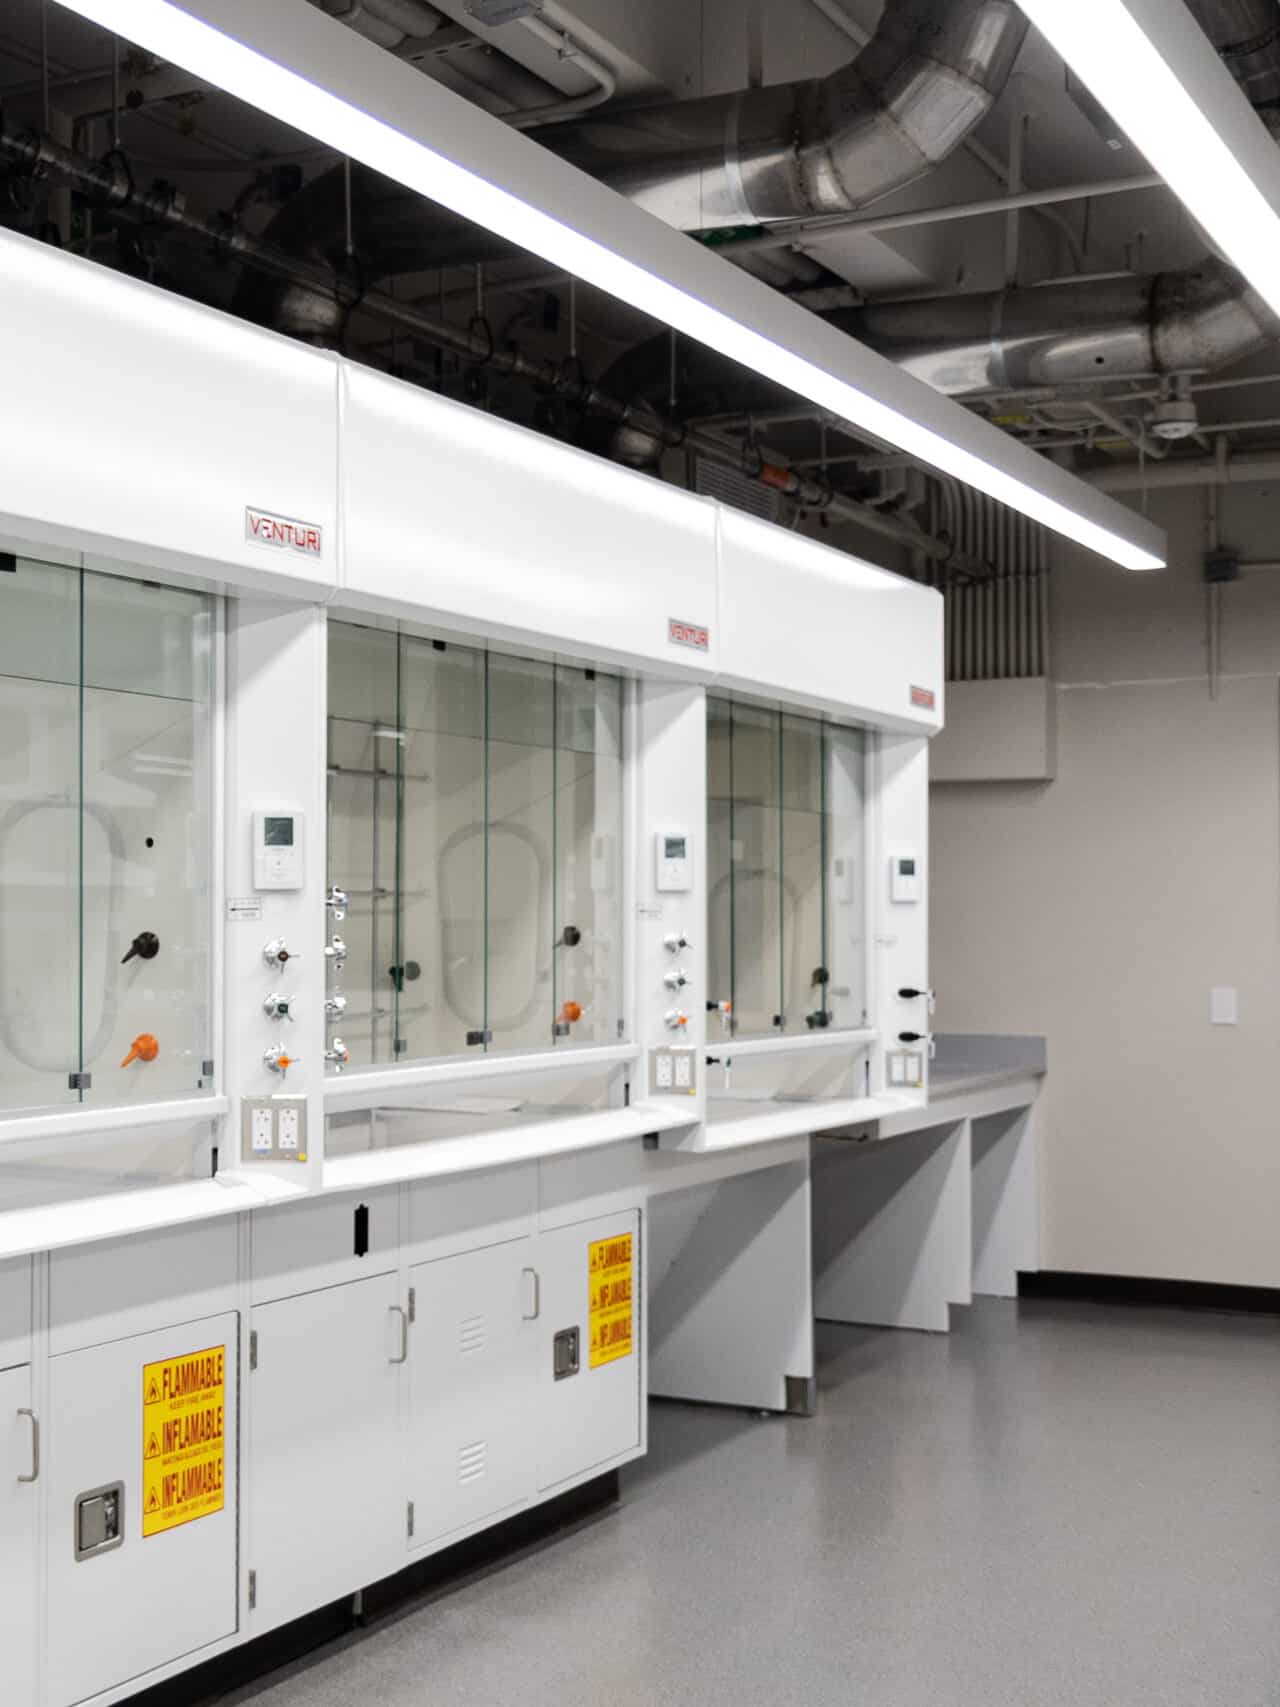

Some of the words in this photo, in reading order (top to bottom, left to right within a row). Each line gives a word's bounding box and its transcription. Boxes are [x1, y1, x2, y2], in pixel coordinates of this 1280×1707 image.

[249, 513, 320, 552] VENTURI
[162, 1353, 222, 1401] FLAMMABLE
[162, 1405, 222, 1456] INFLAMABLE
[162, 1457, 222, 1509] INFLAMMABLE
